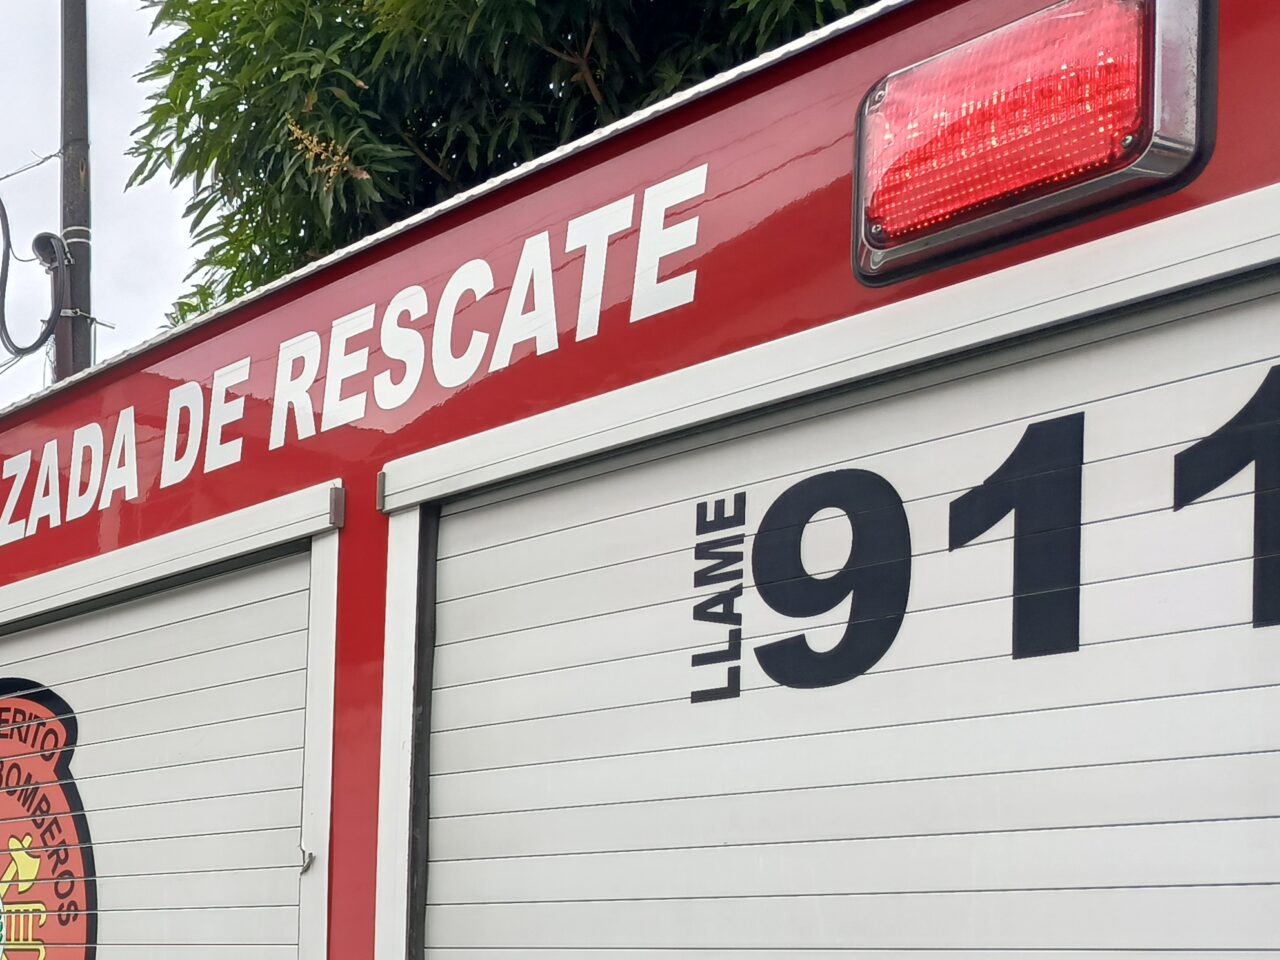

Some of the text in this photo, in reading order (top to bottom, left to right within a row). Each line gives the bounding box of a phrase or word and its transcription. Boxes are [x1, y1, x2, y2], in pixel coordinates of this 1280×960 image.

[159, 356, 250, 489] DE
[268, 163, 708, 450] RESCATE
[690, 491, 746, 704] LLAME
[751, 365, 1280, 690] 911
